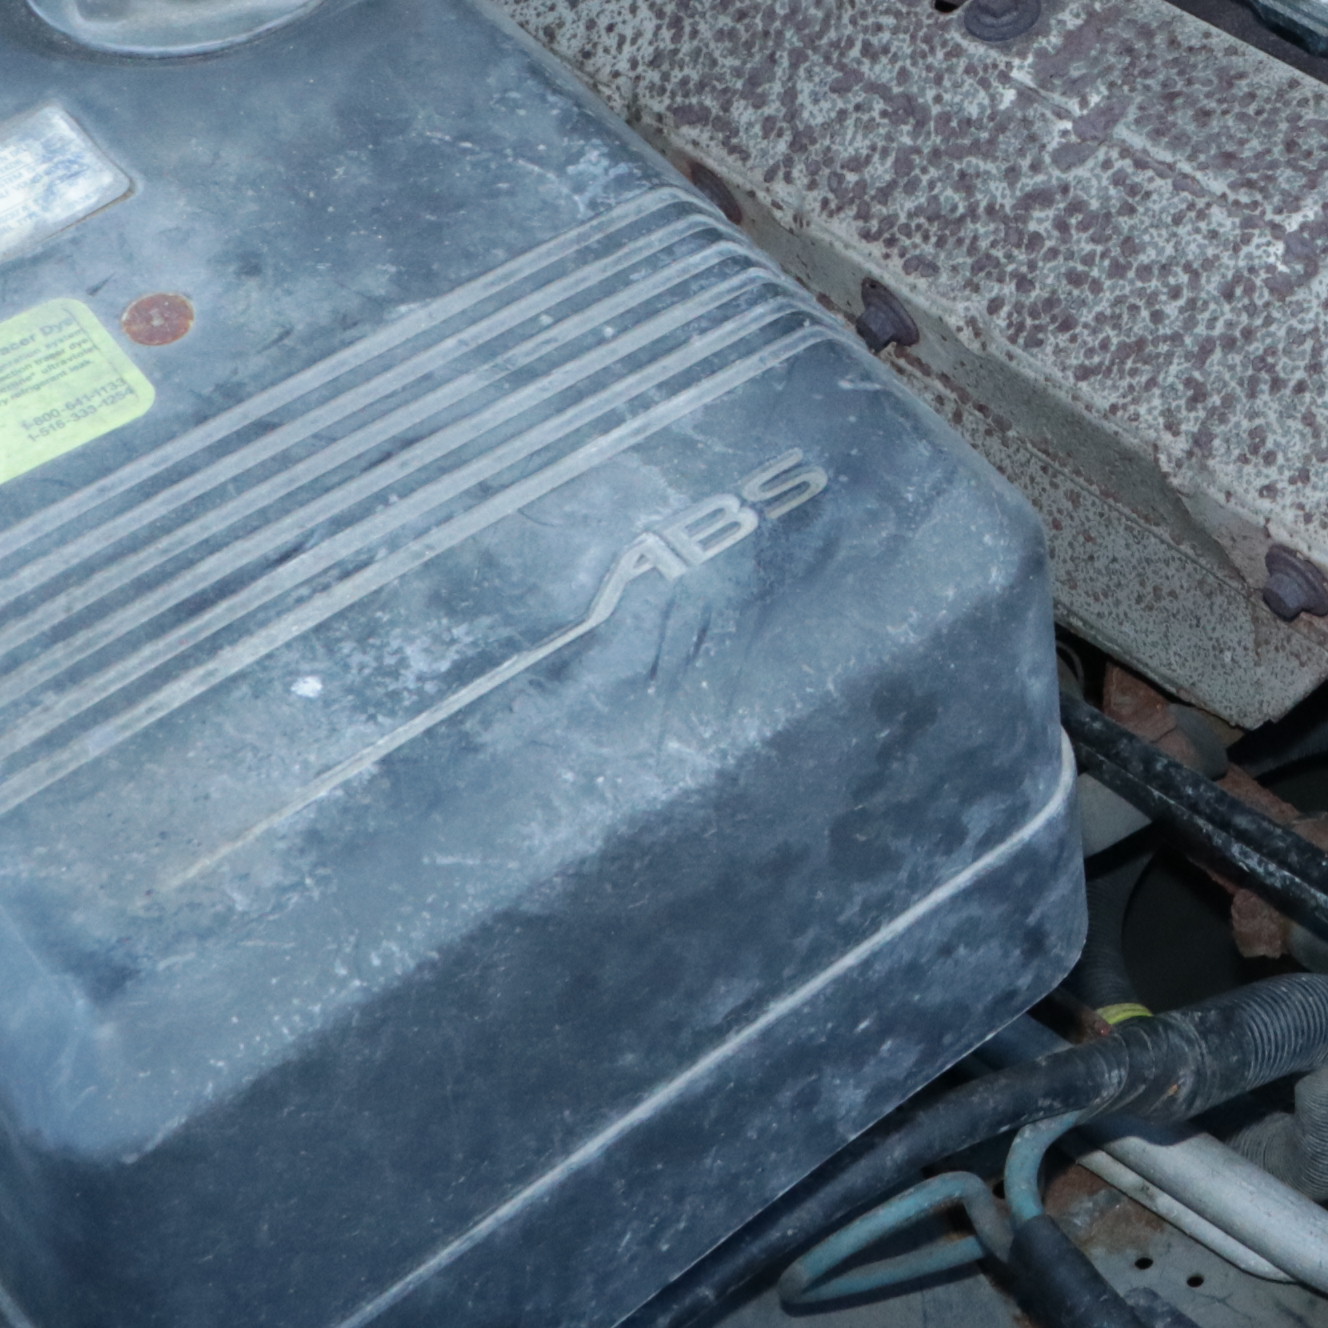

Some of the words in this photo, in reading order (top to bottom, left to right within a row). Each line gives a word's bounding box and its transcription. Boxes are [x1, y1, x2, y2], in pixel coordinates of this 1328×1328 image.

[40, 316, 75, 337] Dye
[69, 338, 89, 352] dye
[598, 446, 828, 612] ABS
